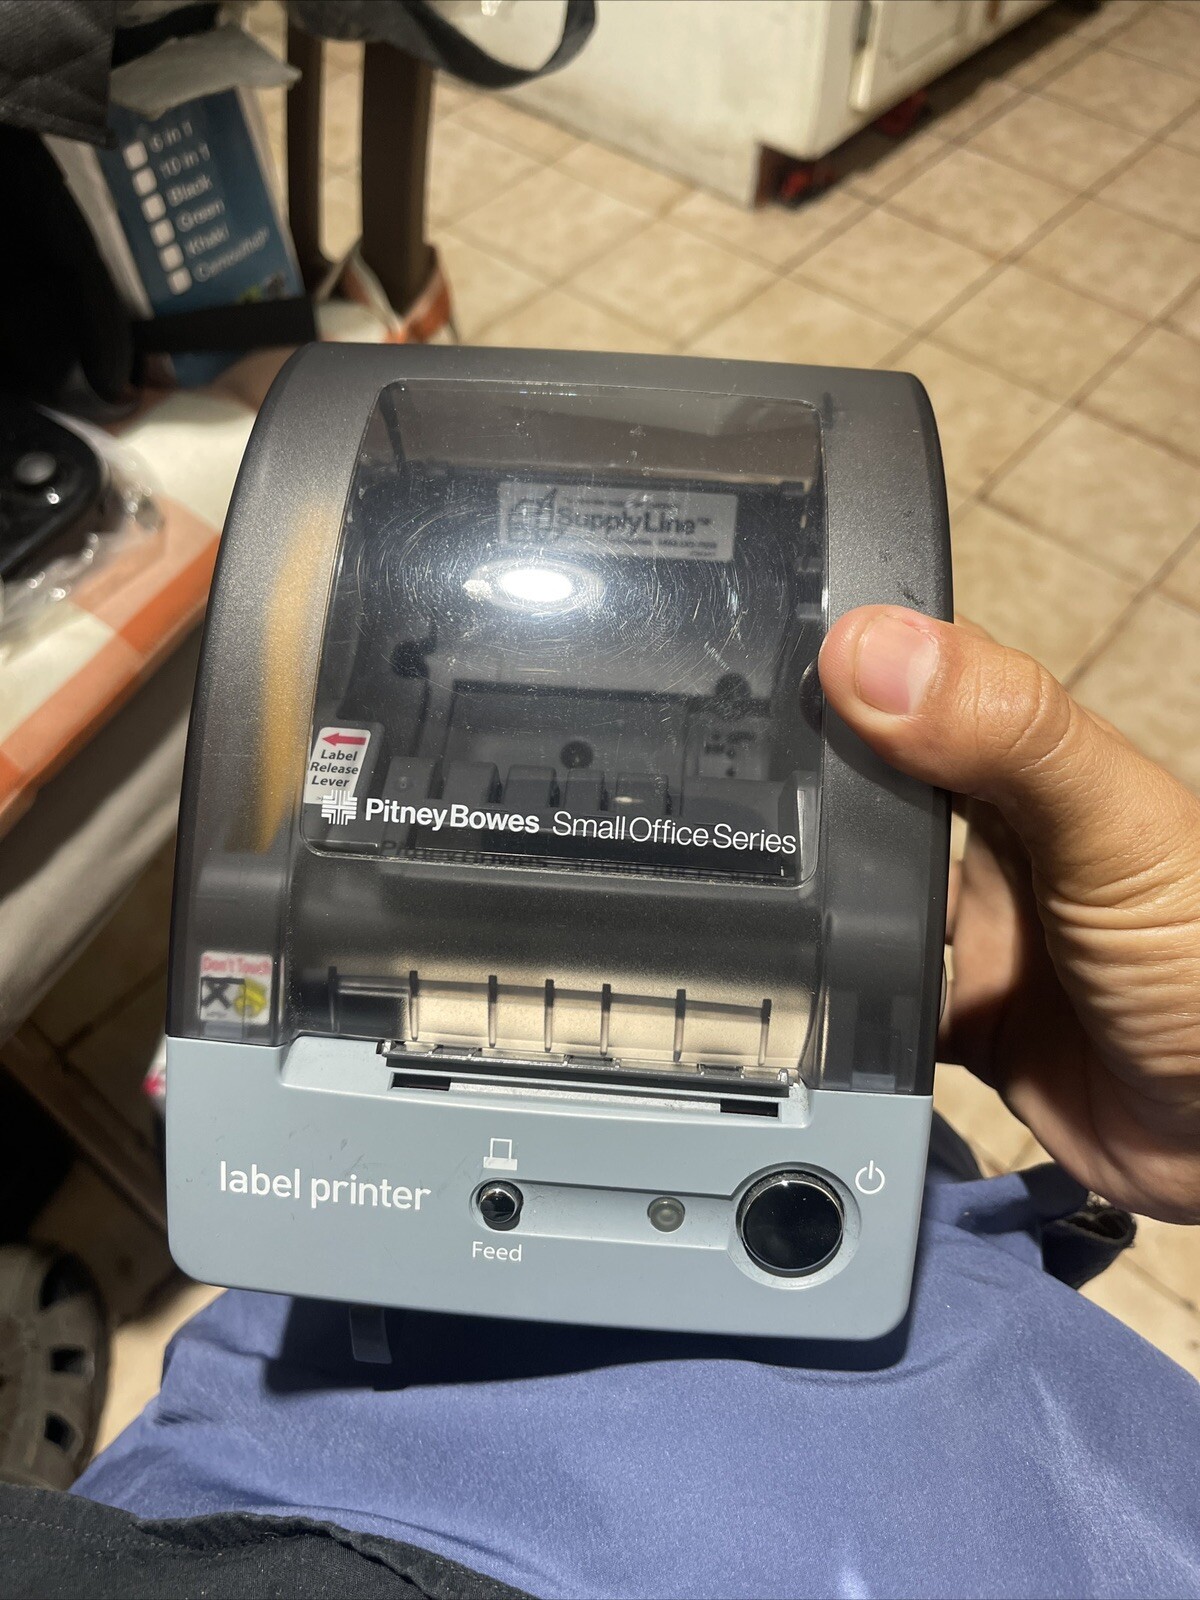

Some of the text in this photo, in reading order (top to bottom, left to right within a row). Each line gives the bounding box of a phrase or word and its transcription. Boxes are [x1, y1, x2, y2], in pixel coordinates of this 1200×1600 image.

[167, 174, 212, 207] Black
[176, 198, 225, 232] Green
[320, 749, 358, 762] Label
[309, 761, 359, 775] Release
[311, 774, 350, 788] Lever
[219, 1160, 433, 1212] label printer
[472, 1240, 523, 1264] Feed
